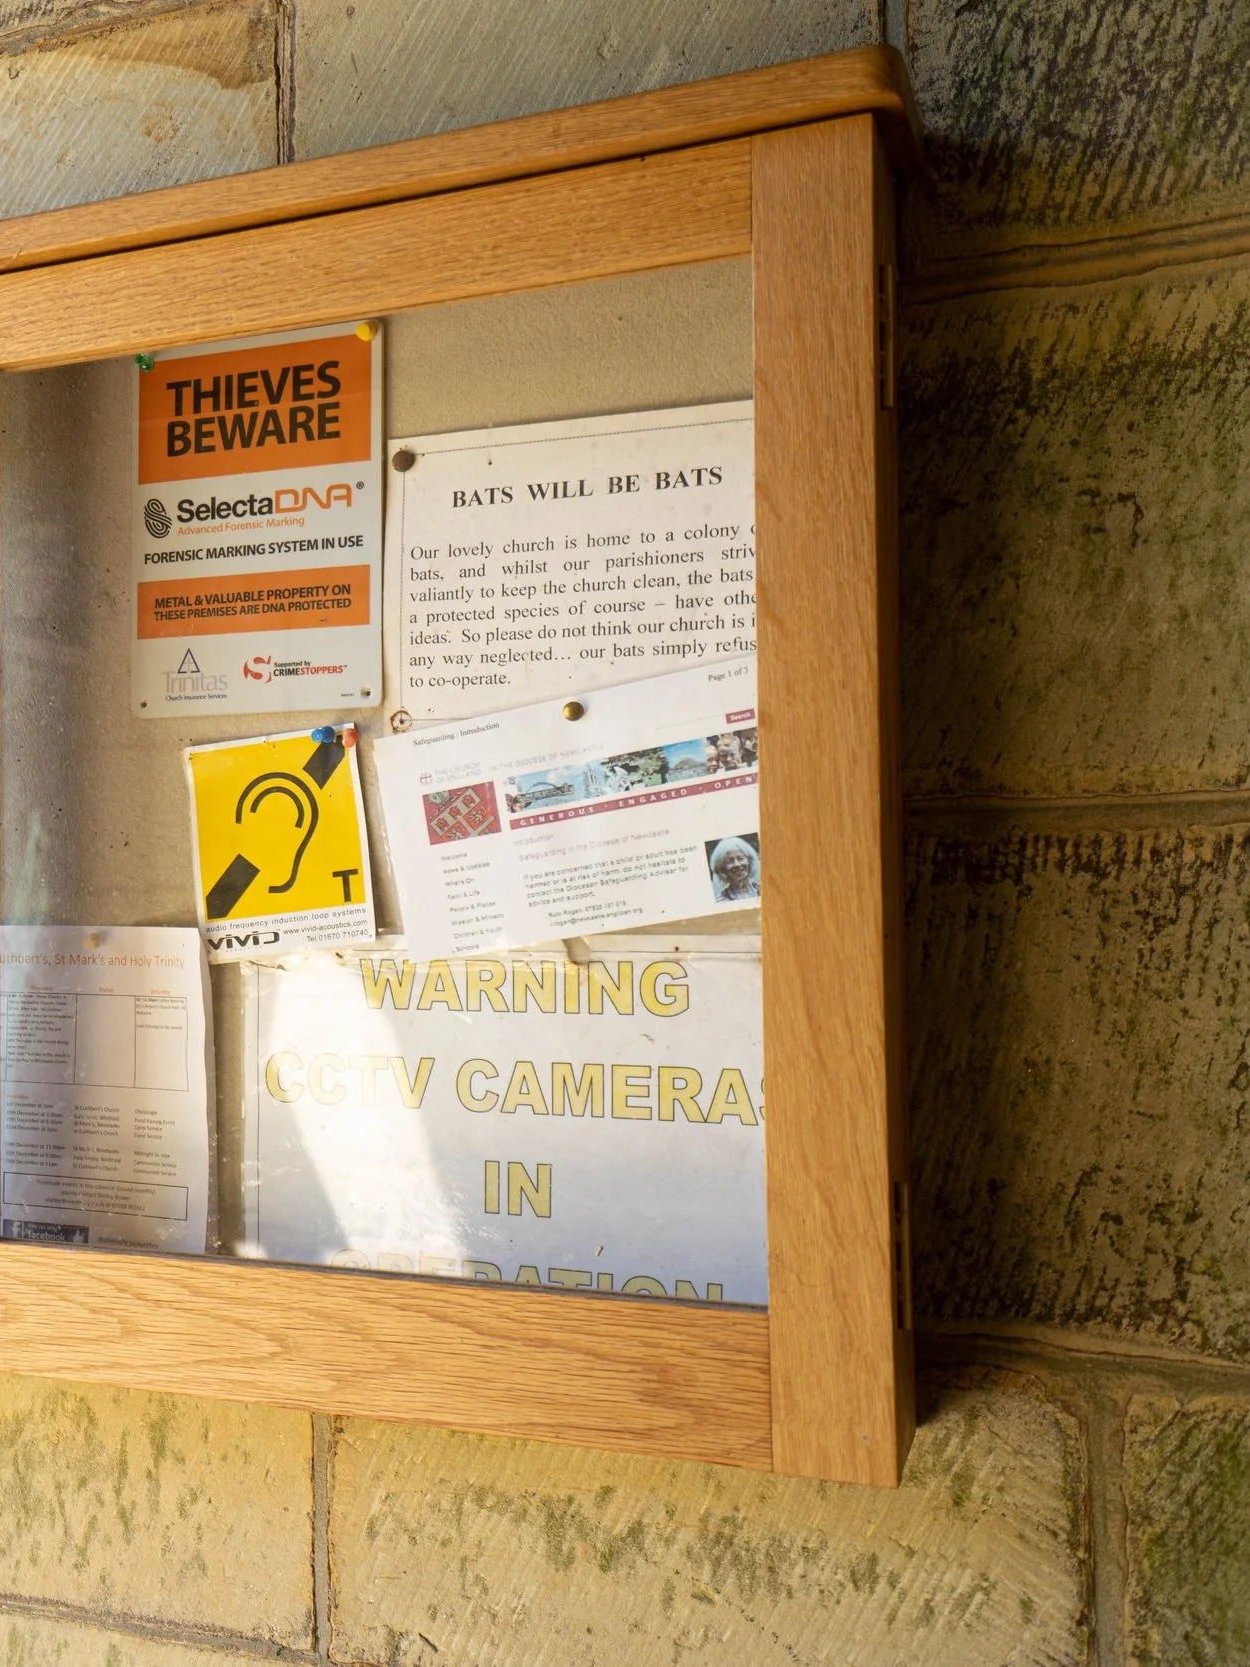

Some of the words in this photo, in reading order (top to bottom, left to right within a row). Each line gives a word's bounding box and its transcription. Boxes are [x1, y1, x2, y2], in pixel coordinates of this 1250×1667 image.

[166, 360, 340, 417] THIEVES
[167, 402, 340, 457] BEWARE
[452, 485, 513, 508] BATS
[526, 479, 593, 500] WILL
[608, 474, 640, 494] BE
[654, 466, 722, 490] BATS
[177, 522, 223, 535] Advanced
[224, 519, 264, 531] Forensic
[265, 516, 304, 528] Marking
[144, 548, 203, 564] FORENSIC
[205, 543, 265, 559] MARKING
[268, 538, 318, 554] SYSTEM
[321, 537, 334, 549] IN
[337, 534, 363, 548] USE
[410, 545, 440, 560] Our
[446, 541, 493, 558] lovely
[502, 536, 554, 553] church
[564, 534, 577, 549] is
[586, 533, 630, 547] home
[639, 530, 655, 543] to
[664, 530, 674, 542] a
[683, 524, 740, 540] colony
[410, 567, 444, 582] bats,
[458, 562, 486, 578] and
[501, 559, 548, 578] whilst
[562, 559, 590, 571] our
[605, 550, 704, 572] parishioners
[154, 595, 192, 608] METAL
[194, 594, 203, 606] &
[204, 590, 264, 604] VALUABLE
[266, 585, 329, 600] PROPERTY
[331, 583, 350, 595] ON
[409, 585, 474, 603] valiantly
[480, 586, 494, 598] to
[501, 582, 536, 599] keep
[542, 579, 566, 594] the
[572, 575, 626, 592] church
[632, 573, 680, 589] clean,
[686, 570, 712, 585] the
[720, 567, 753, 582] bats
[153, 609, 185, 621] THESE
[187, 605, 237, 618] PREMISES
[238, 604, 259, 615] ARE
[261, 602, 286, 613] DNA
[287, 597, 351, 611] PROTECTED
[409, 613, 418, 624] a
[425, 605, 494, 627] protected
[504, 602, 559, 622] species
[567, 599, 587, 615] of
[593, 600, 645, 614] course
[674, 594, 714, 609] have
[410, 629, 451, 645] ideas.
[461, 628, 480, 642] So
[485, 626, 532, 645] please
[537, 624, 557, 639] do
[561, 624, 586, 638] not
[591, 619, 632, 636] think
[637, 622, 665, 633] our
[669, 614, 724, 632] church
[731, 614, 744, 628] is
[409, 655, 435, 669] any
[442, 654, 473, 668] way
[579, 647, 606, 659] our
[613, 642, 644, 658] bats
[652, 638, 707, 658] simply
[715, 634, 756, 653] refus
[164, 672, 228, 692] Trinitas
[274, 666, 343, 676] CRIMESTOPPERS
[409, 676, 423, 687] to
[428, 673, 510, 689] co-operate.
[707, 673, 725, 681] Page
[733, 667, 743, 676] of
[743, 666, 748, 674] 3
[730, 712, 751, 721] Search
[412, 733, 455, 746] Safeguarding
[459, 722, 499, 736] Introduction
[520, 806, 594, 827] GENEROUS
[619, 788, 688, 807] ENGAGED
[714, 776, 752, 790] OPEN
[332, 869, 358, 902] T
[526, 888, 552, 898] contact
[565, 881, 598, 892] Diocesan
[599, 872, 647, 886] Safeguarding
[206, 924, 227, 932] audio
[229, 920, 268, 929] frequency
[271, 914, 308, 924] induction
[311, 912, 329, 920] loop
[332, 907, 366, 918] systems
[283, 919, 367, 935] www.vivid-acoustics.com
[343, 929, 369, 939] 710740
[54, 953, 66, 965] St
[68, 953, 105, 965] Mark's
[107, 954, 127, 966] and
[129, 954, 152, 969] Holy
[153, 954, 184, 970] Trinity
[360, 958, 690, 1017] WARNING
[265, 1052, 436, 1109] CCTV
[456, 1058, 764, 1126] CAMERA
[484, 1160, 552, 1218] IN
[28, 1230, 65, 1241] facebook
